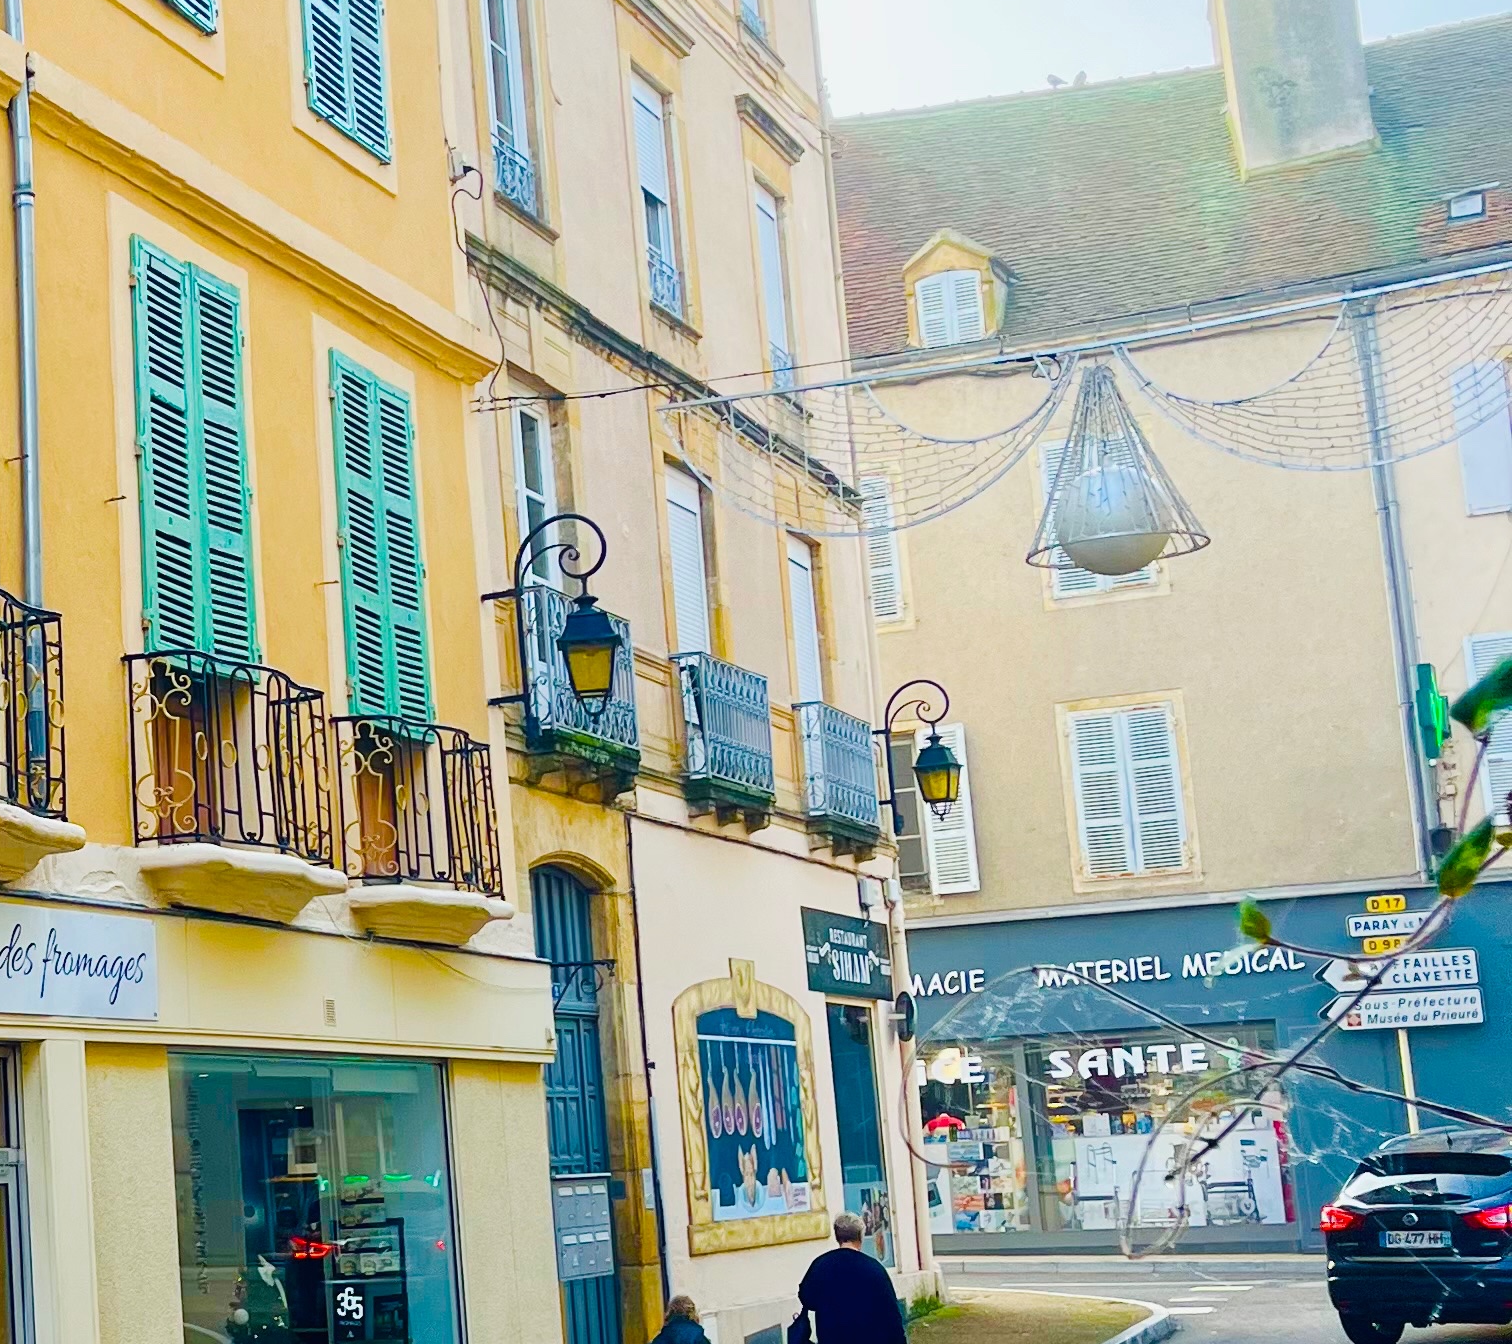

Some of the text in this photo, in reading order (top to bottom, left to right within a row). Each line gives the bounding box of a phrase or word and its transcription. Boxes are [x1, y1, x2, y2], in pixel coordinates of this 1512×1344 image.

[1371, 898, 1401, 910] D 17
[1354, 918, 1399, 931] PARAY
[1403, 920, 1414, 929] LE
[41, 928, 148, 1005] fromages
[1038, 956, 1171, 988] MATERIEL
[1182, 948, 1306, 979] MEDICAL
[1393, 969, 1473, 984] CLAYETTE
[1367, 1009, 1479, 1024] Musée du Prieuré
[1047, 1042, 1209, 1080] SANTE
[336, 1287, 364, 1320] 365
